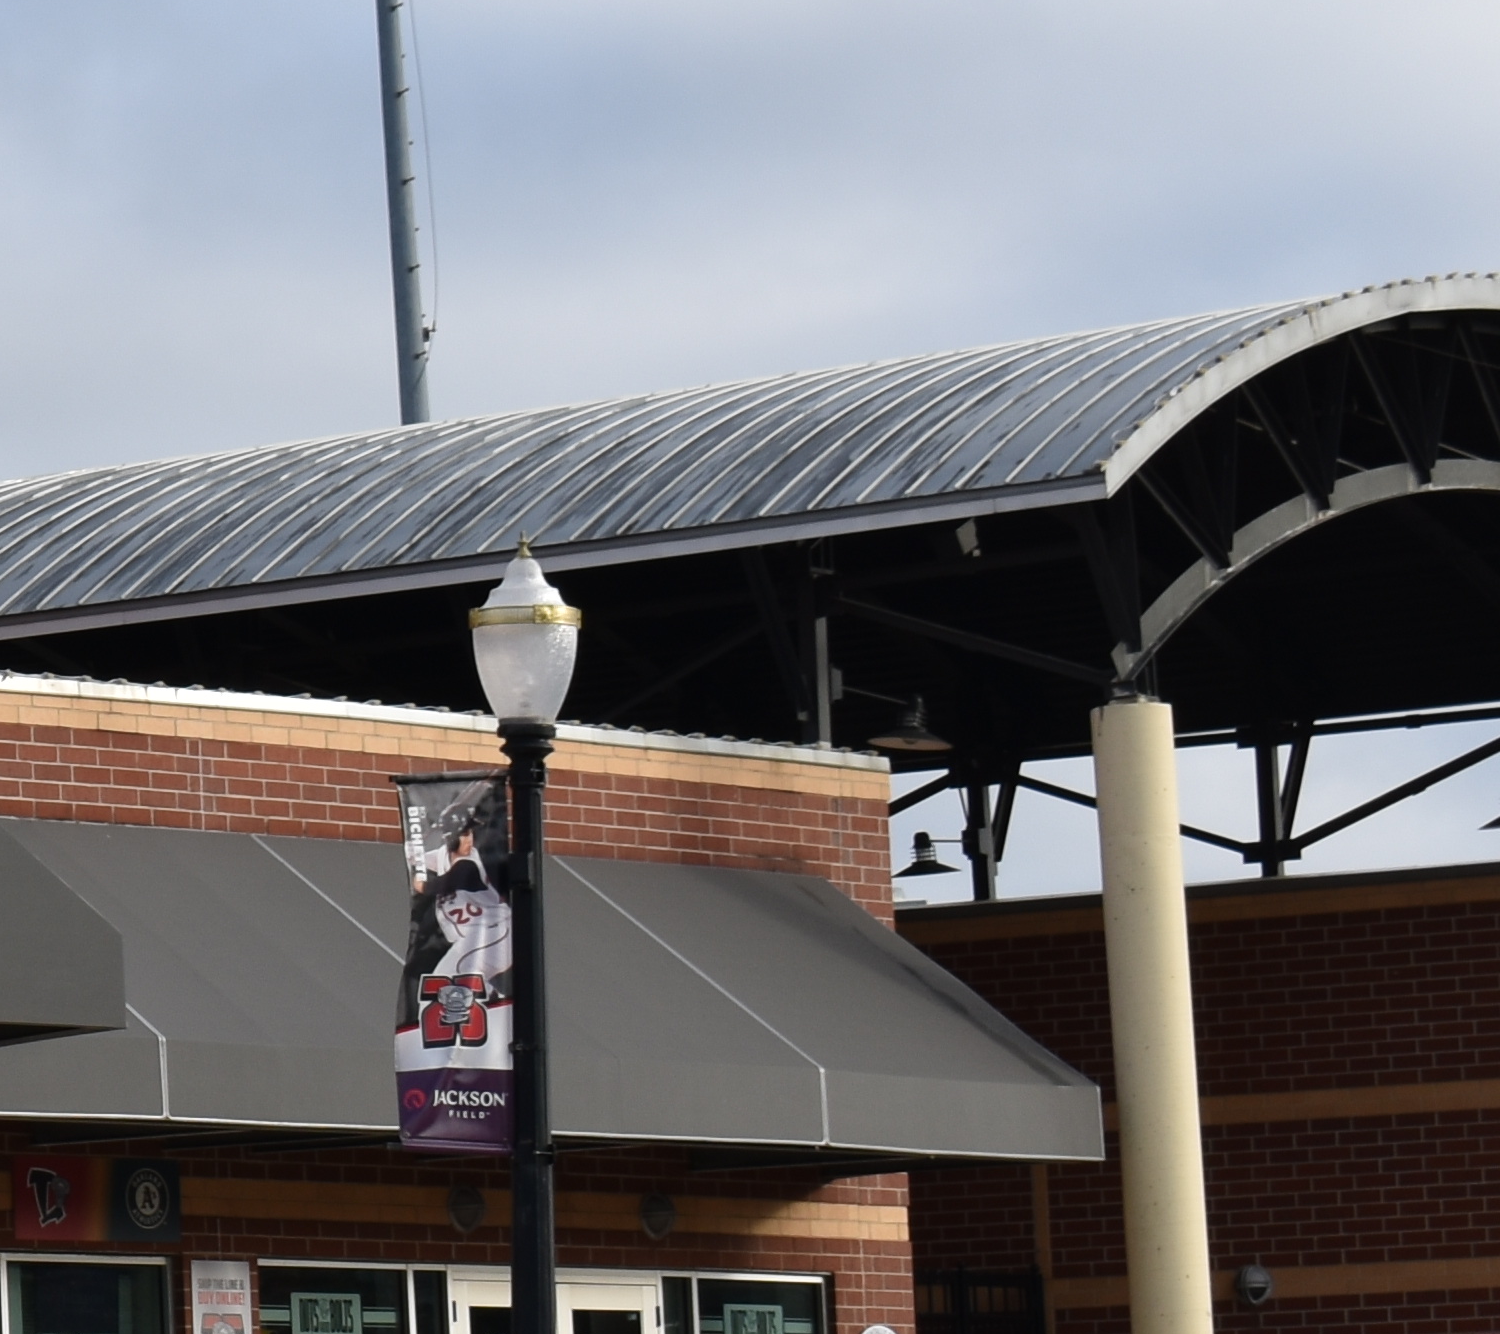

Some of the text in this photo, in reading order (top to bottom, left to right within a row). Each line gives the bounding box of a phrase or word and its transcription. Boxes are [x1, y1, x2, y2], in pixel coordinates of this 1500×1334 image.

[448, 903, 483, 924] 20
[433, 1089, 506, 1107] JACKSON
[448, 1109, 486, 1119] FIELD
